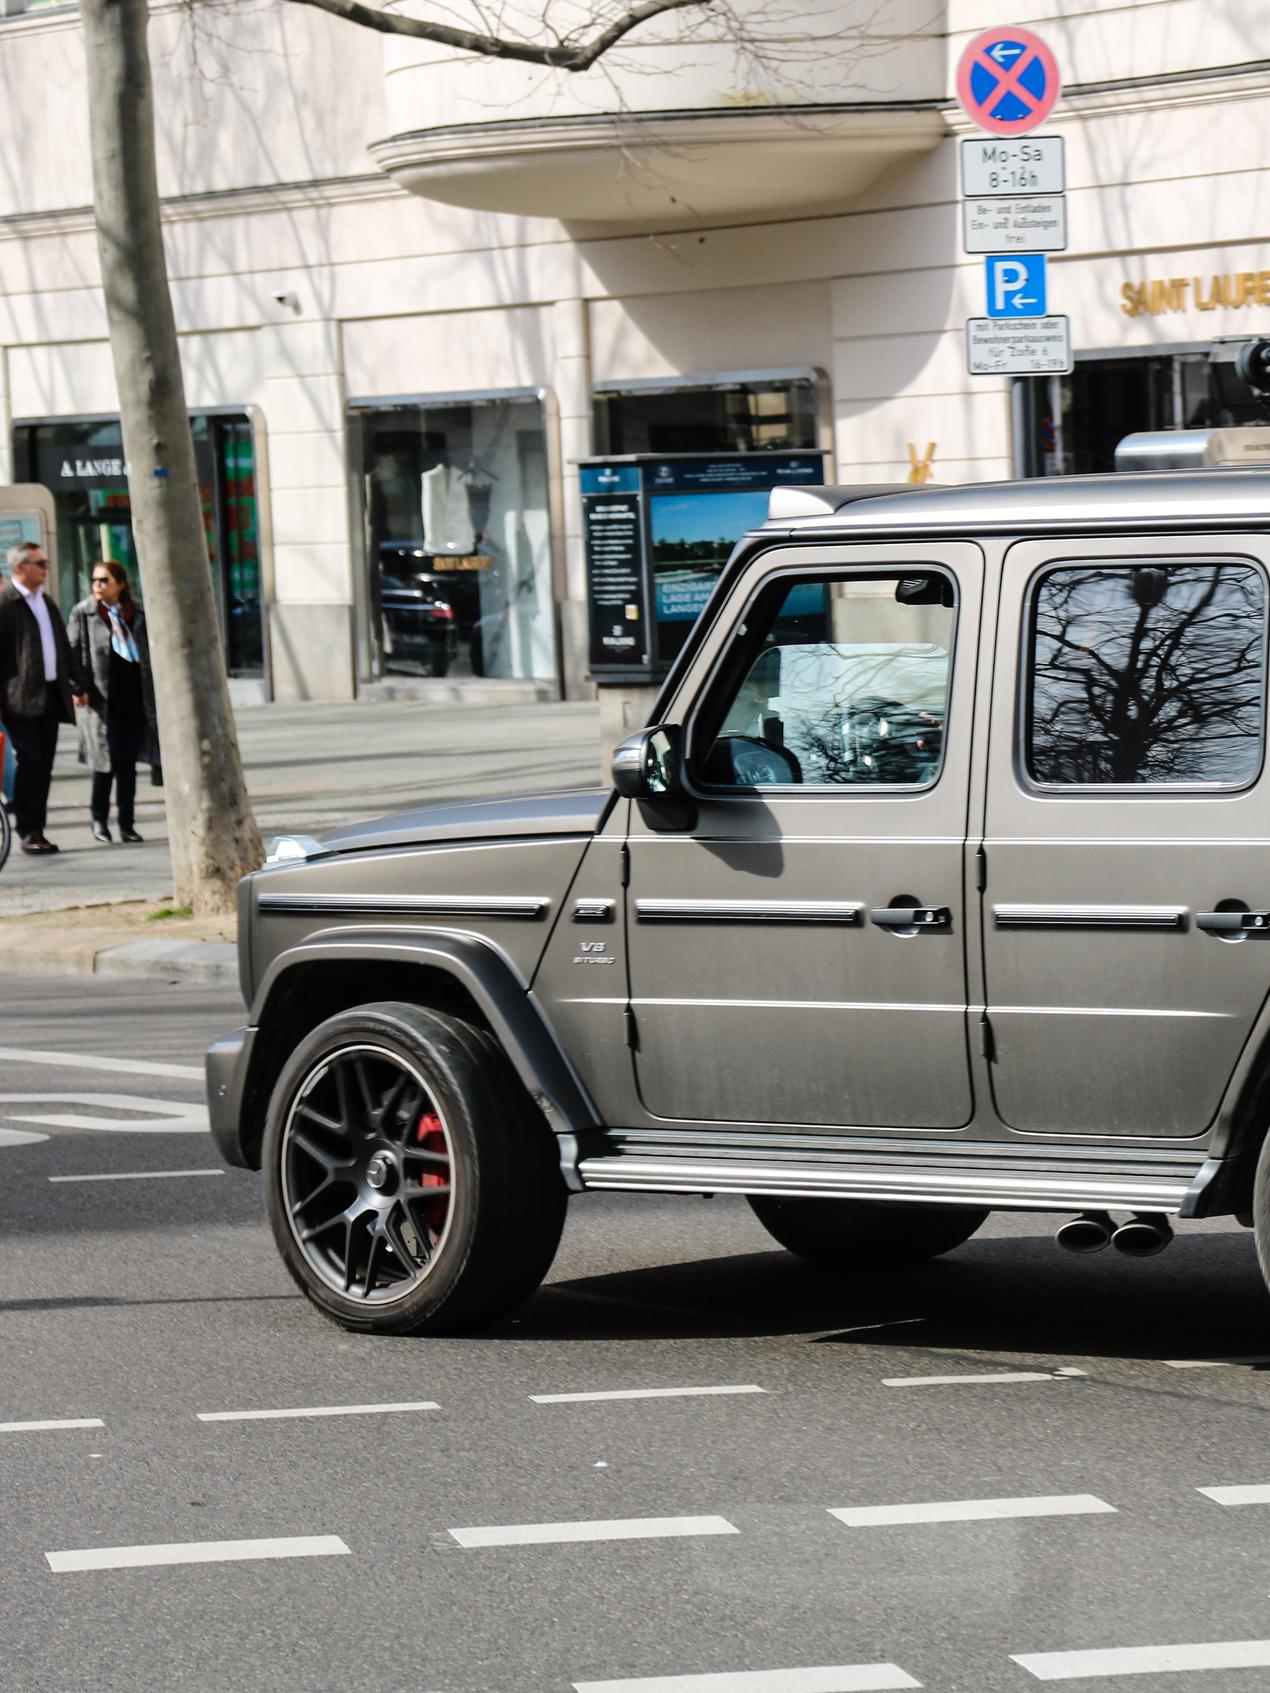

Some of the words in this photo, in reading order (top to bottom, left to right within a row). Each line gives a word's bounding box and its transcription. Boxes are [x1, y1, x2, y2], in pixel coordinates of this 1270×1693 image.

[981, 145, 1043, 163] Mo-Sa
[988, 170, 1039, 188] 8-16h
[996, 204, 1012, 214] und
[1014, 203, 1053, 214] Entladen
[993, 220, 1009, 229] und
[1011, 218, 1059, 230] Aussteigen
[1005, 233, 1025, 243] frei
[993, 260, 1029, 310] P
[1120, 277, 1189, 318] SAINT
[975, 322, 989, 331] mit
[992, 320, 1037, 331] Parkschein
[1041, 320, 1060, 330] oder
[988, 346, 1005, 357] für
[1009, 346, 1037, 357] Zone
[76, 459, 122, 476] LANGE
[580, 942, 606, 952] V8
